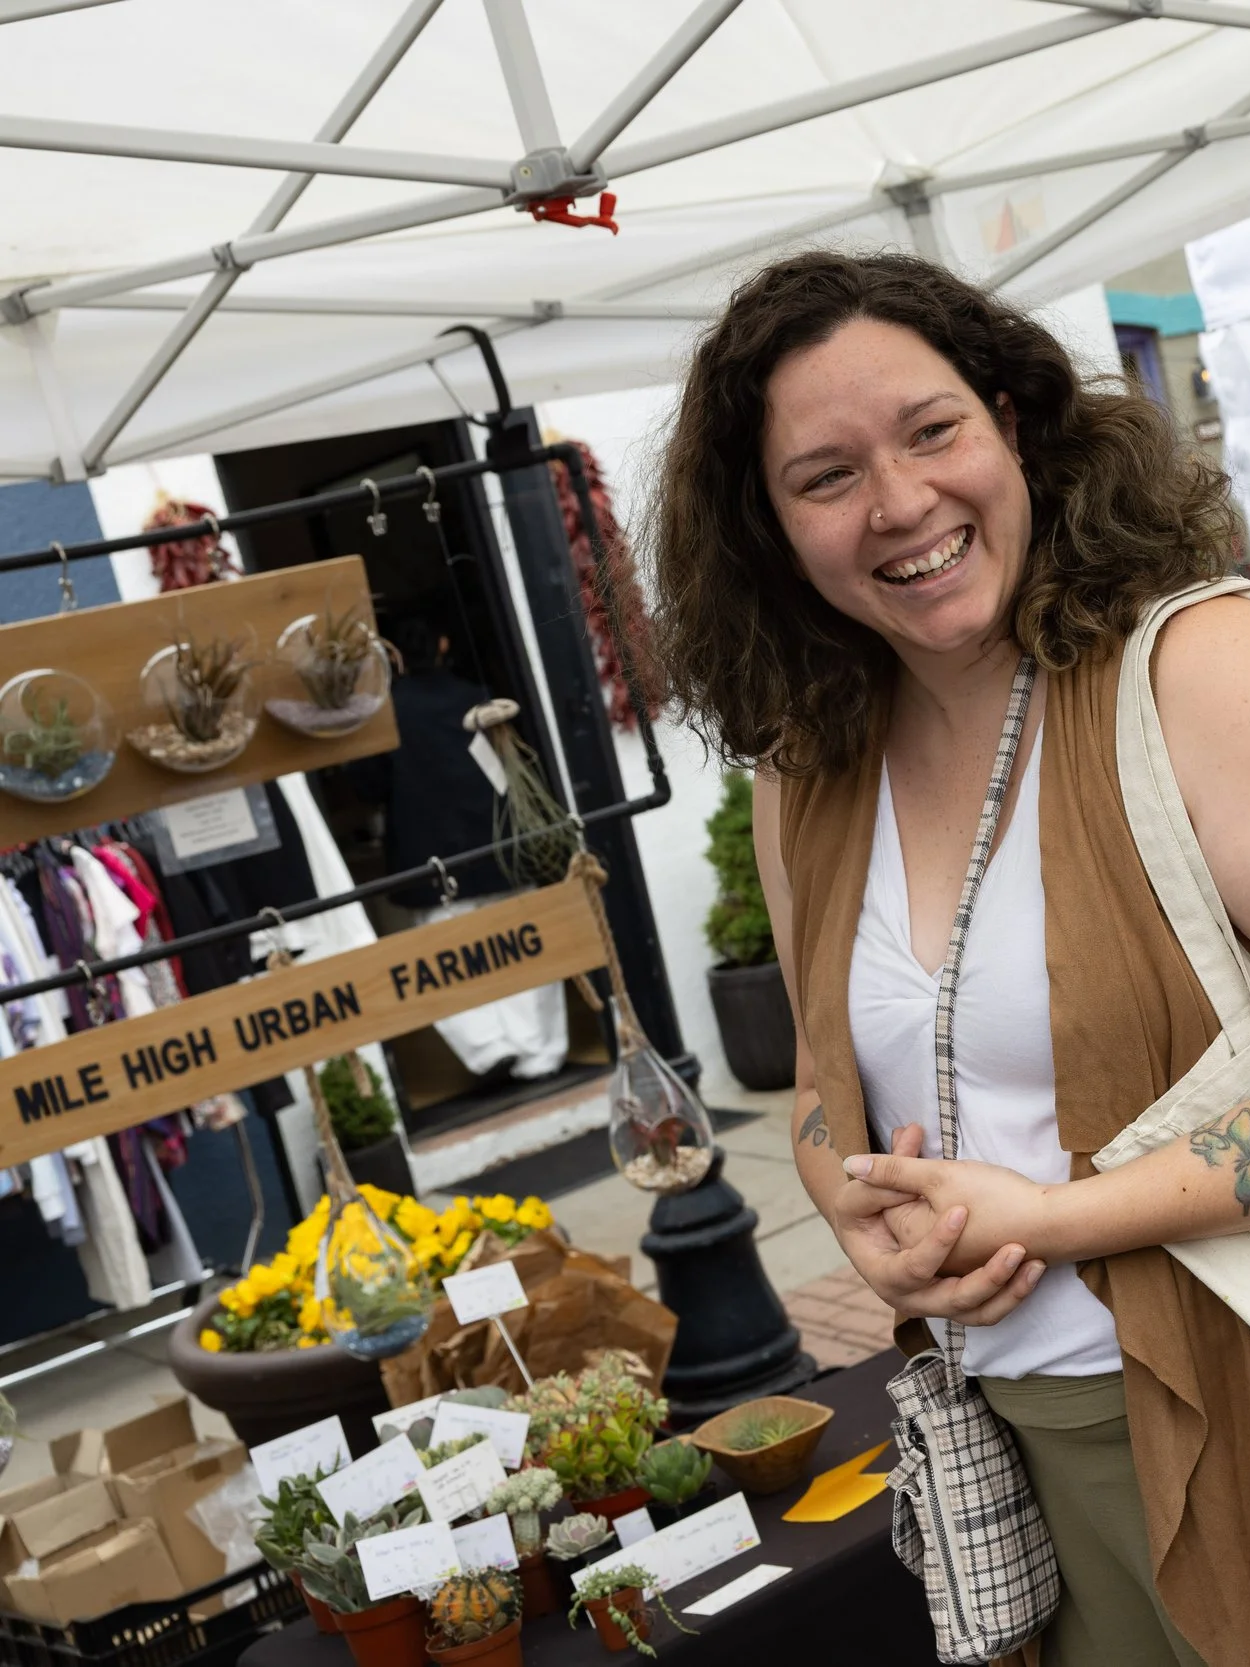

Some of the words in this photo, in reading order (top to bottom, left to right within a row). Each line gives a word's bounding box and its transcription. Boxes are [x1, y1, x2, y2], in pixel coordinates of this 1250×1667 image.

[14, 1064, 109, 1124] MILE
[121, 1028, 216, 1090] HIGH
[234, 982, 361, 1051] URBAN
[390, 923, 543, 1000] FARMING
